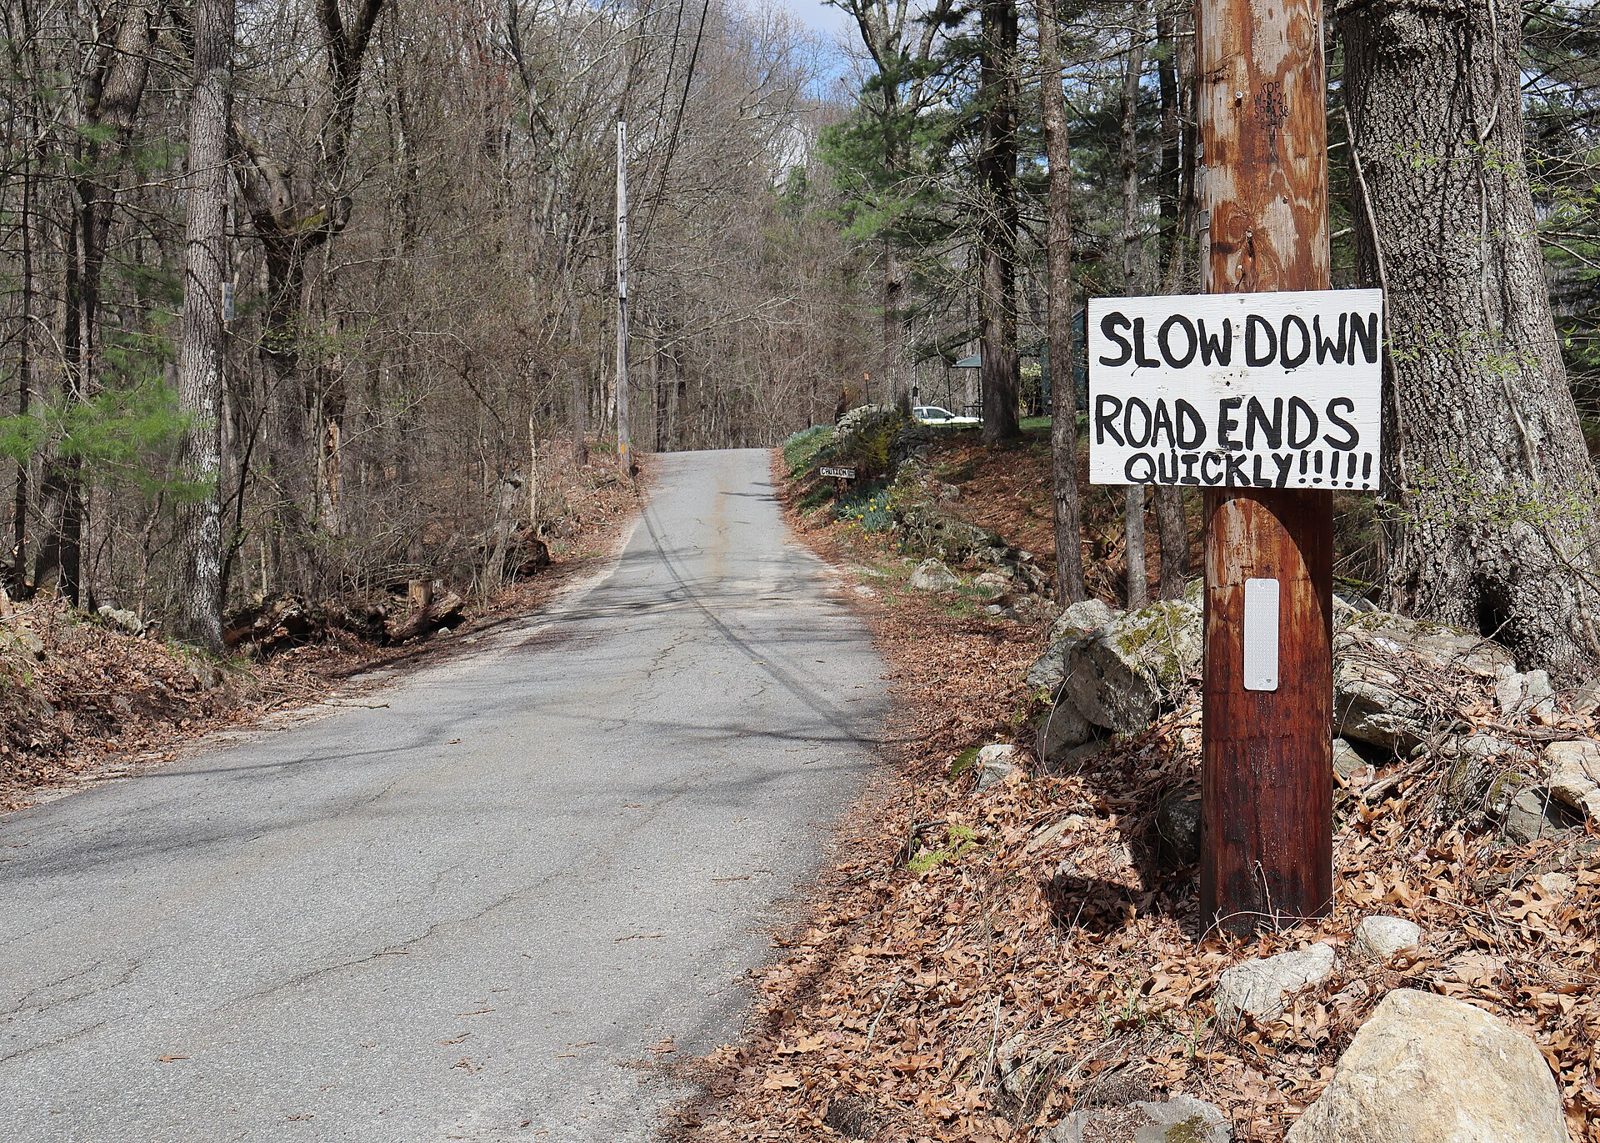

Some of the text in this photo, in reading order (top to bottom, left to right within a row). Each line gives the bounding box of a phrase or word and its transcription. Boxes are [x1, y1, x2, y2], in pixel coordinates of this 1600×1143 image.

[1098, 311, 1378, 370] SLOW DOWN
[1095, 394, 1360, 451] ROAD ENDS
[1124, 450, 1373, 490] QUICKLY!!!!!
